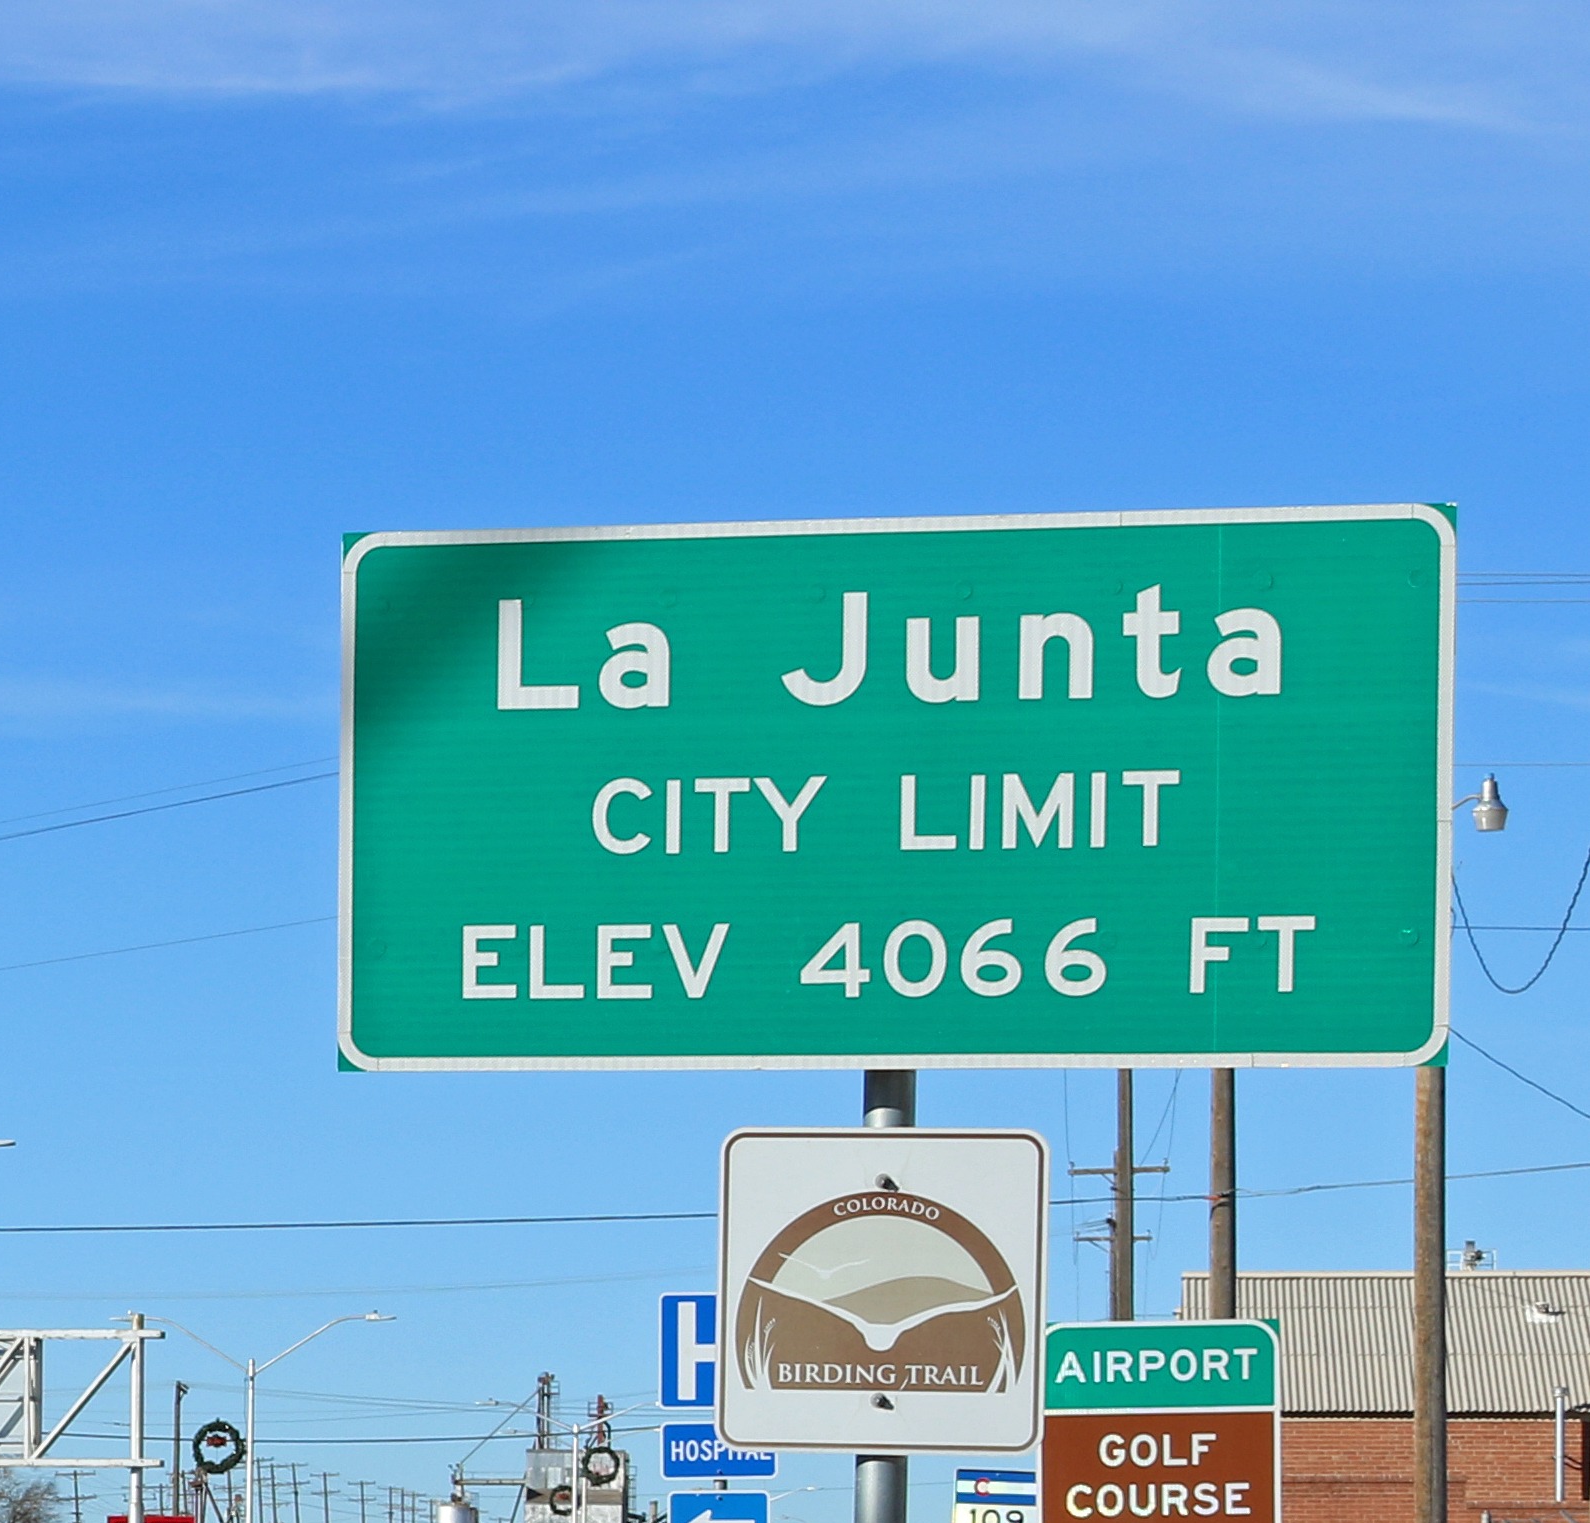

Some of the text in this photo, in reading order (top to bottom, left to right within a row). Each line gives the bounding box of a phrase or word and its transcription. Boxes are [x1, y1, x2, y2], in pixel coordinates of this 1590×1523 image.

[497, 583, 1283, 710] La Junta
[592, 769, 1182, 855] CITY LIMIT
[462, 914, 1316, 1000] ELEV 4066 FT
[832, 1197, 941, 1221] COLORADO
[677, 1301, 717, 1401] H
[1054, 1347, 1259, 1384] AIRPORT
[777, 1363, 984, 1387] BIRDING TRAIL
[1098, 1433, 1218, 1468] GOLF
[1065, 1482, 1252, 1519] COURSE
